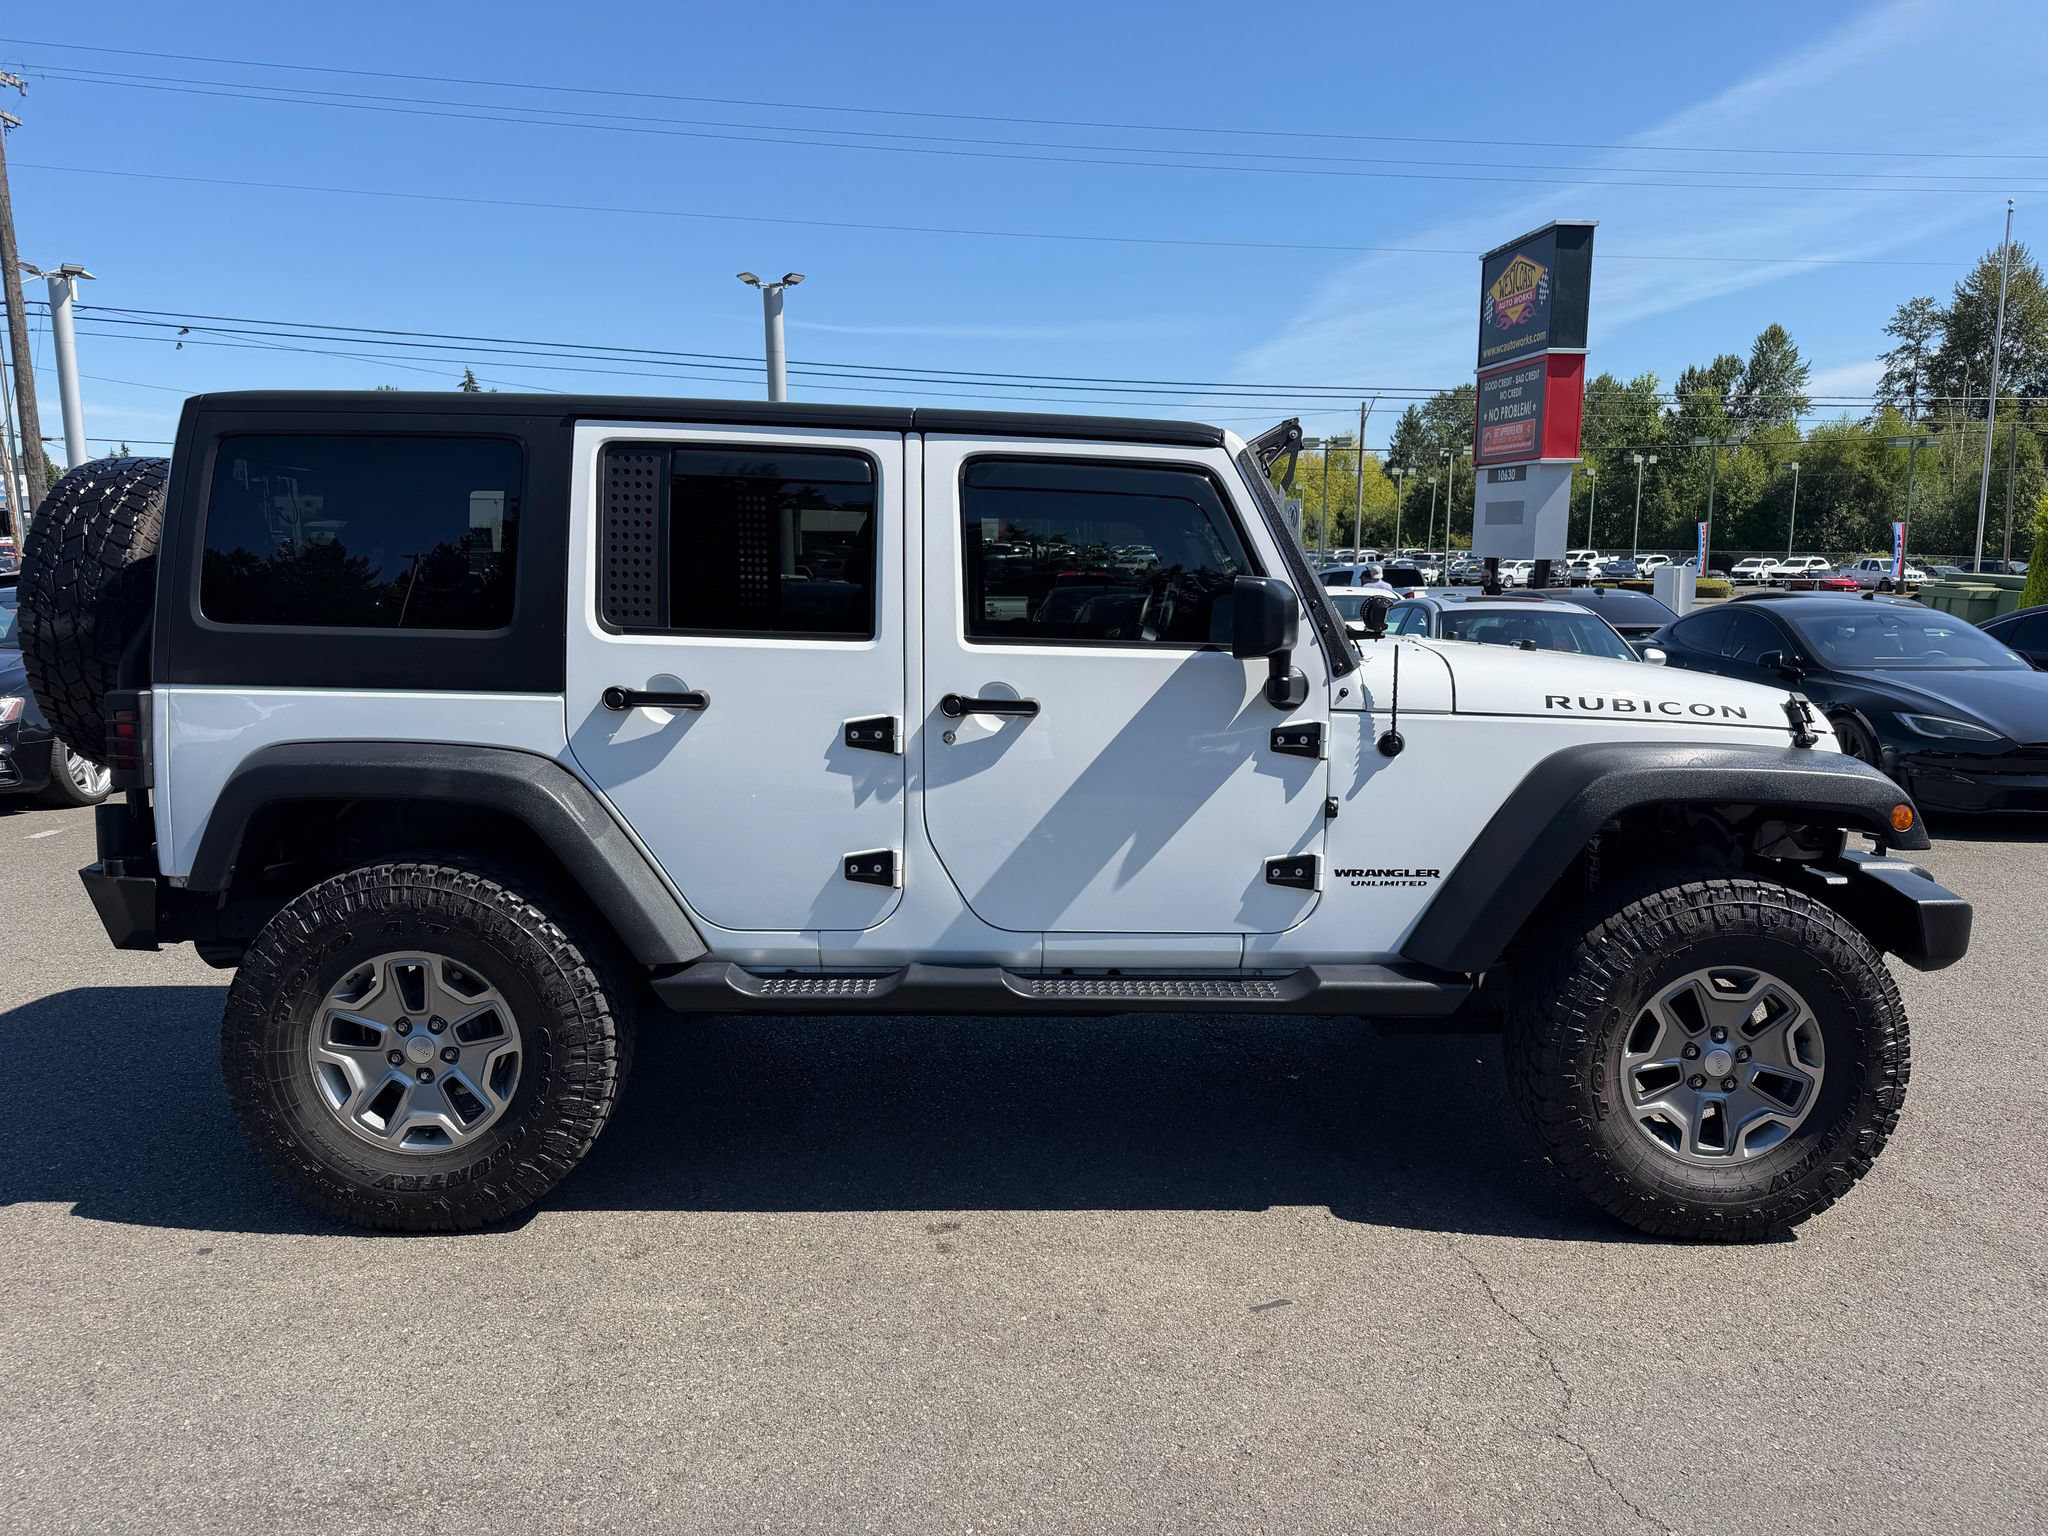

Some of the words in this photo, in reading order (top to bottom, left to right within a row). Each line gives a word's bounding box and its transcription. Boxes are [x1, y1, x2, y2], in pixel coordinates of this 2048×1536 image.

[1498, 298, 1513, 310] AUTO
[1513, 291, 1533, 305] WORKS
[1483, 331, 1546, 357] www.wcautoworks.com
[1484, 379, 1497, 391] GOOD
[1498, 376, 1513, 389] CREDIT
[1515, 374, 1525, 386] BAD
[1525, 369, 1540, 382] CREDIT
[1499, 390, 1507, 401] NO
[1507, 386, 1522, 399] CREDIT
[1488, 408, 1500, 422] NO
[1500, 401, 1532, 420] PROBLEM!
[1497, 468, 1516, 482] 10630
[1545, 694, 1748, 720] RUBICON
[1333, 868, 1441, 879] WRANGLER
[1591, 1006, 1620, 1121] TOYO
[371, 1125, 528, 1192] COUNTRY
